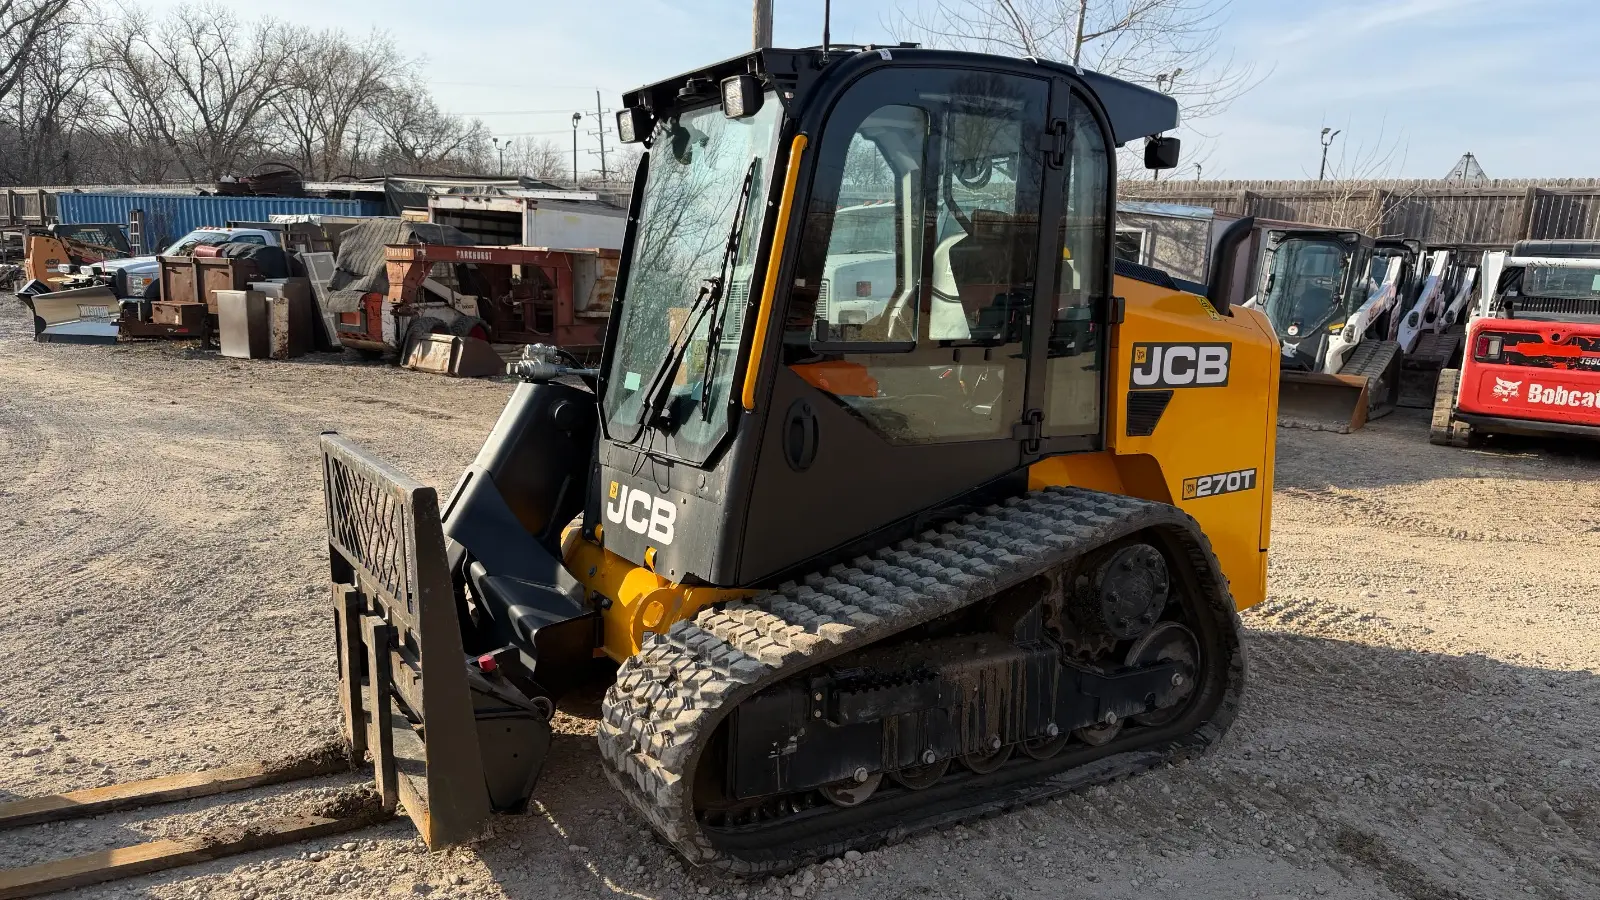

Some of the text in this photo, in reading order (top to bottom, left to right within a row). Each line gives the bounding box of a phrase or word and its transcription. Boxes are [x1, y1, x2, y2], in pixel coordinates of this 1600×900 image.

[456, 250, 492, 260] PARKHURST
[1133, 346, 1228, 385] JCB
[1196, 469, 1255, 497] 270T
[606, 484, 677, 546] JCB
